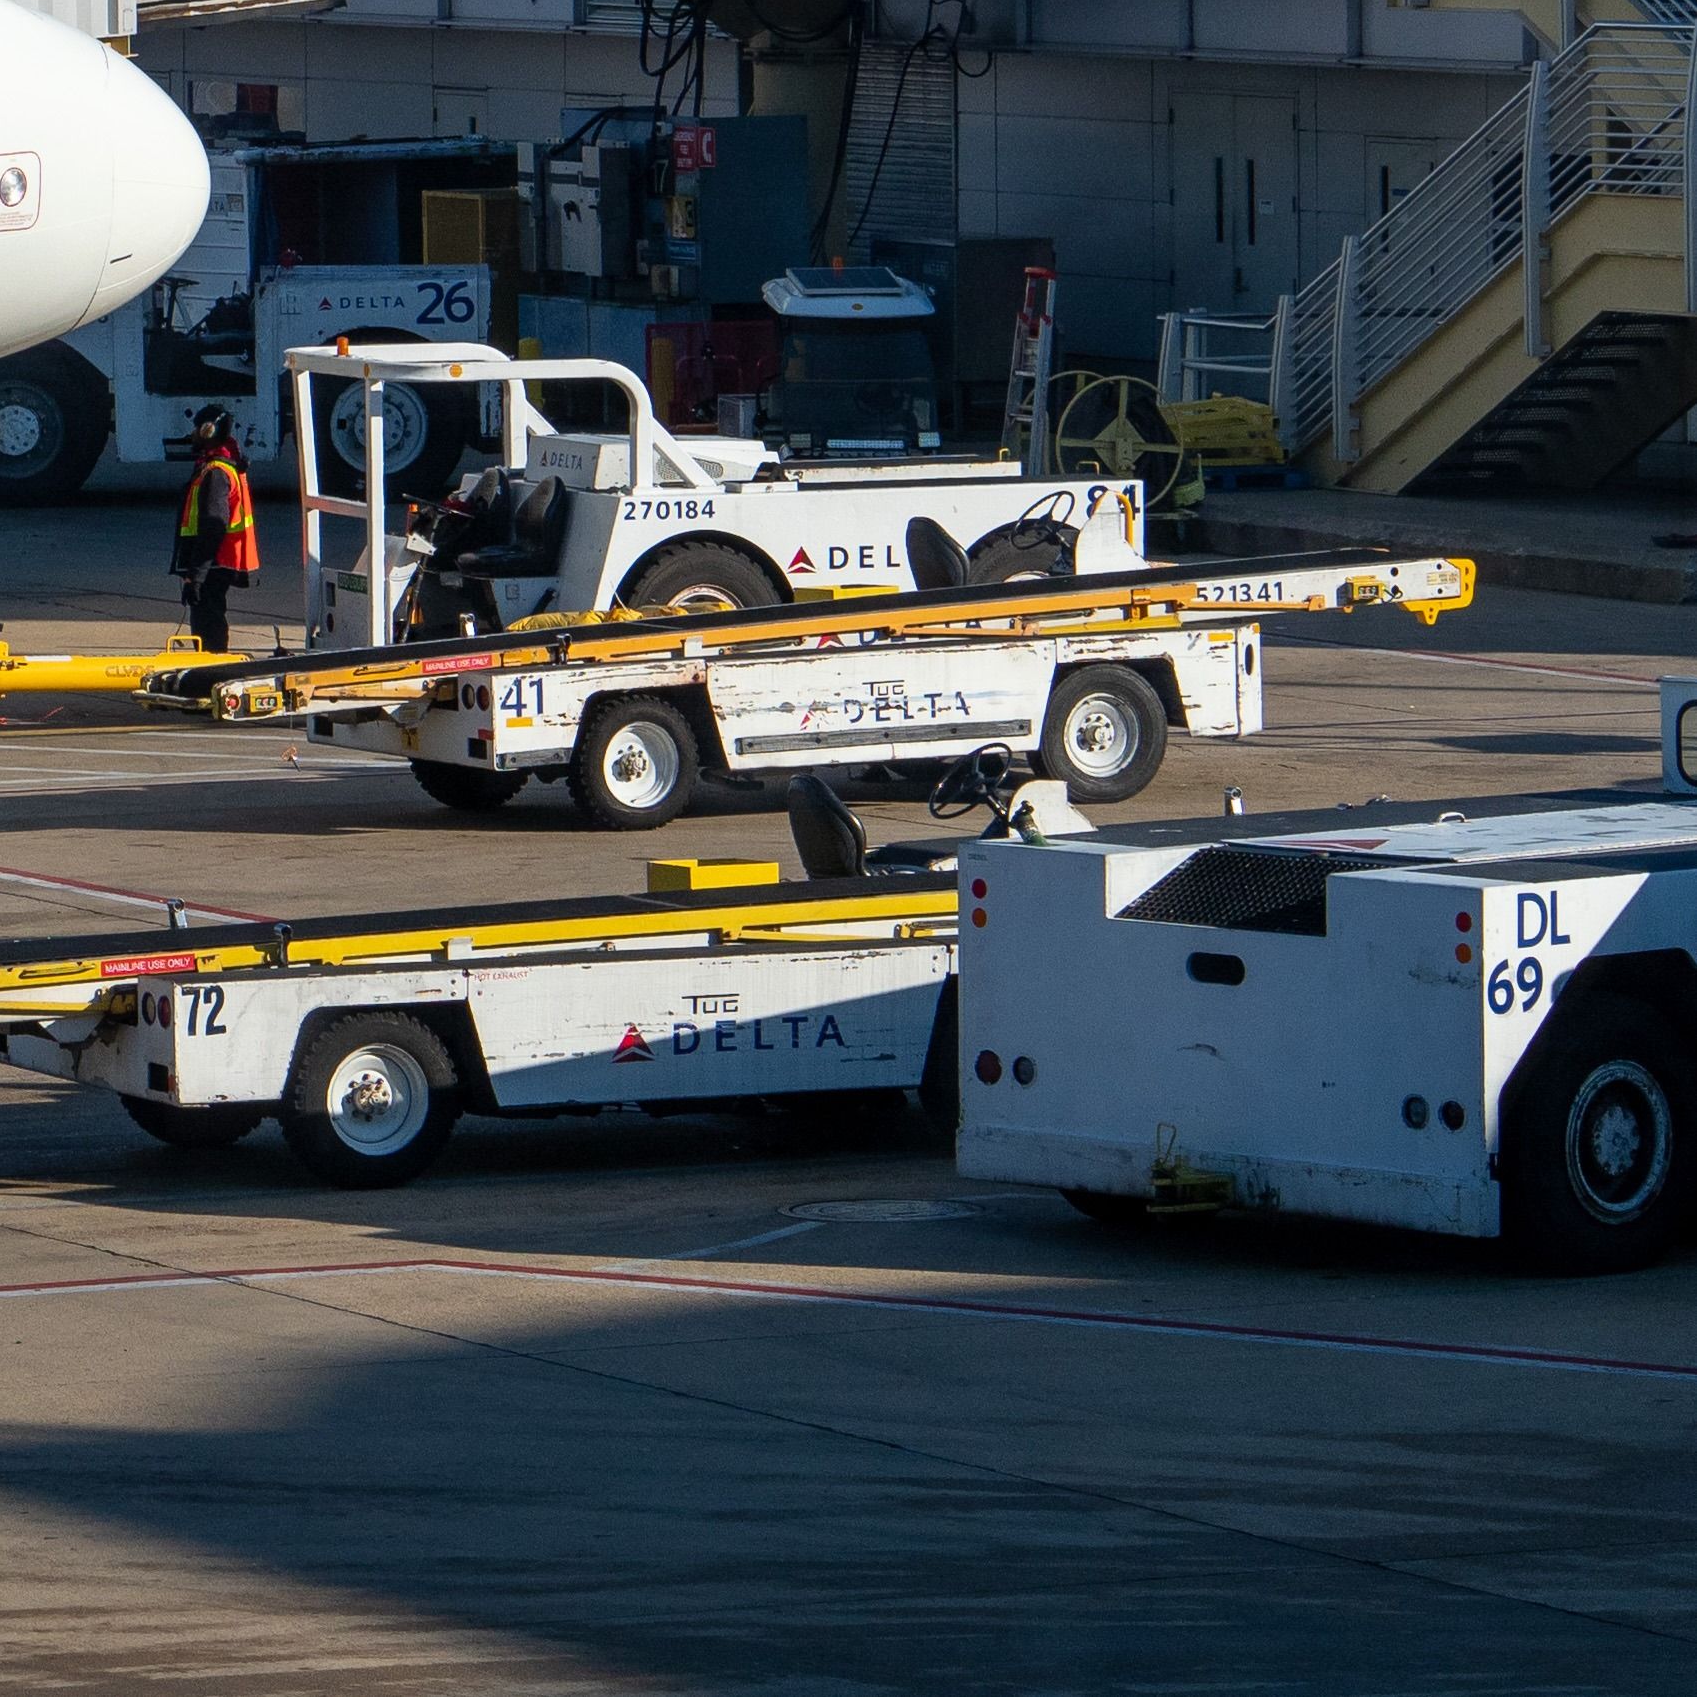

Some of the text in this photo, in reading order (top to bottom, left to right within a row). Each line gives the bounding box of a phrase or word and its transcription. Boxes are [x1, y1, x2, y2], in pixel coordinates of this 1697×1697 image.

[339, 281, 475, 325] DELTA 26
[550, 452, 584, 471] DELTA
[624, 499, 716, 521] 270184
[829, 544, 901, 570] DEL
[500, 676, 544, 718] 41
[843, 690, 972, 724] DELTA
[1517, 890, 1571, 949] DL
[104, 956, 191, 974] MAINLINE USE ONLY
[1487, 956, 1544, 1015] 69
[181, 985, 227, 1036] 72
[672, 1014, 846, 1056] DELTA
